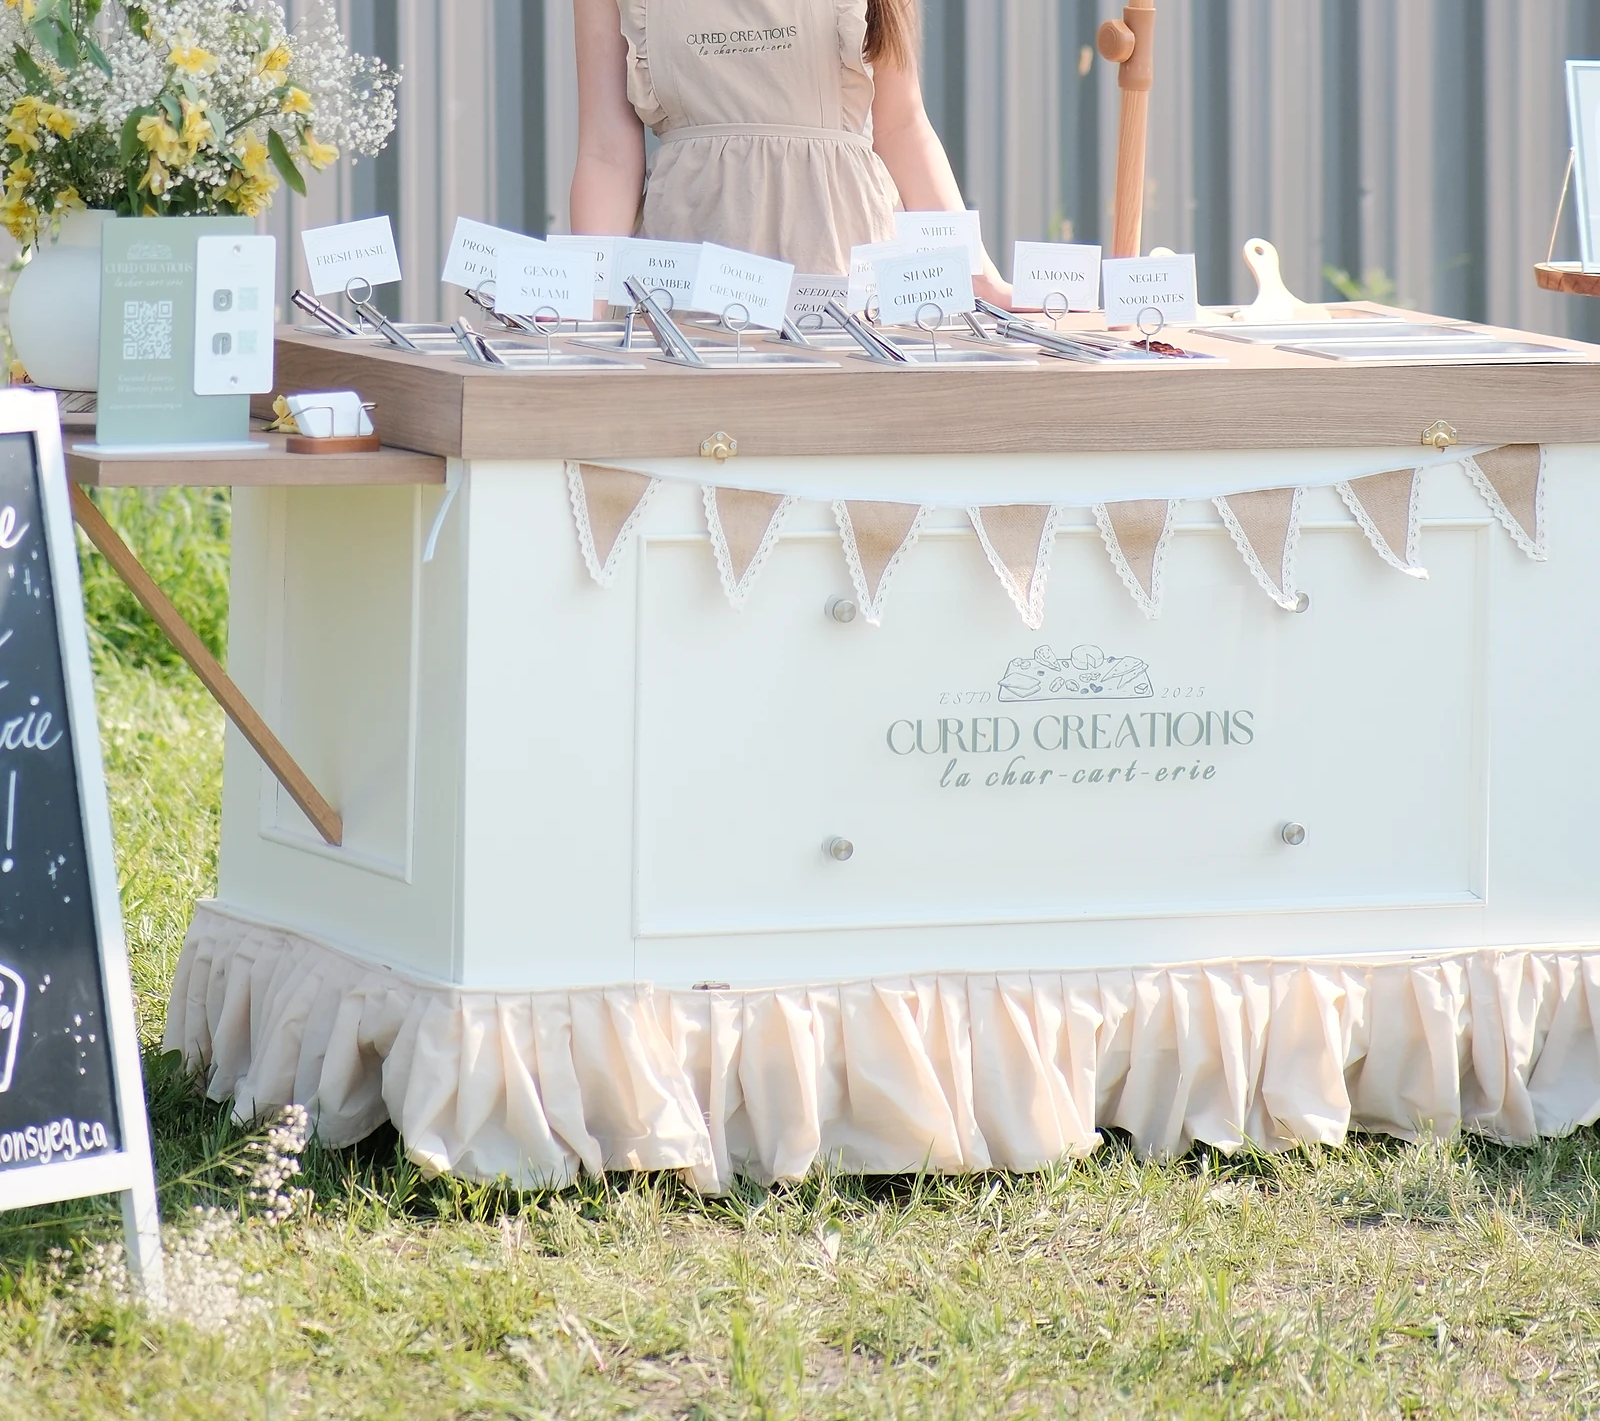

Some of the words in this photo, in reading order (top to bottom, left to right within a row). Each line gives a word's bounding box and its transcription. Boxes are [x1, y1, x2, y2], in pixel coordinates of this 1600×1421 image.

[687, 33, 727, 45] CURED
[730, 26, 797, 42] CREATIONS
[699, 46, 709, 56] la
[921, 226, 956, 237] WHITE
[316, 251, 352, 266] FRESH
[355, 245, 387, 259] BASIL
[464, 261, 477, 273] DI
[648, 257, 678, 269] BABY
[523, 265, 568, 279] GENOA
[720, 263, 764, 285] DOUBLE
[903, 266, 944, 283] SHARP
[1028, 270, 1085, 282] ALMONDS
[1128, 273, 1169, 284] NEGLET
[626, 275, 691, 290] CUMBER
[520, 286, 570, 300] SALAMI
[893, 287, 954, 307] CHEDDAR
[1119, 295, 1148, 306] NOOR
[1152, 293, 1185, 304] DATES
[939, 691, 992, 705] ESTD
[1161, 686, 1205, 699] 2025
[886, 716, 1021, 756] CURED
[1032, 709, 1254, 751] CREATIONS
[939, 758, 971, 788] la
[985, 755, 1217, 787] char-cart-erie
